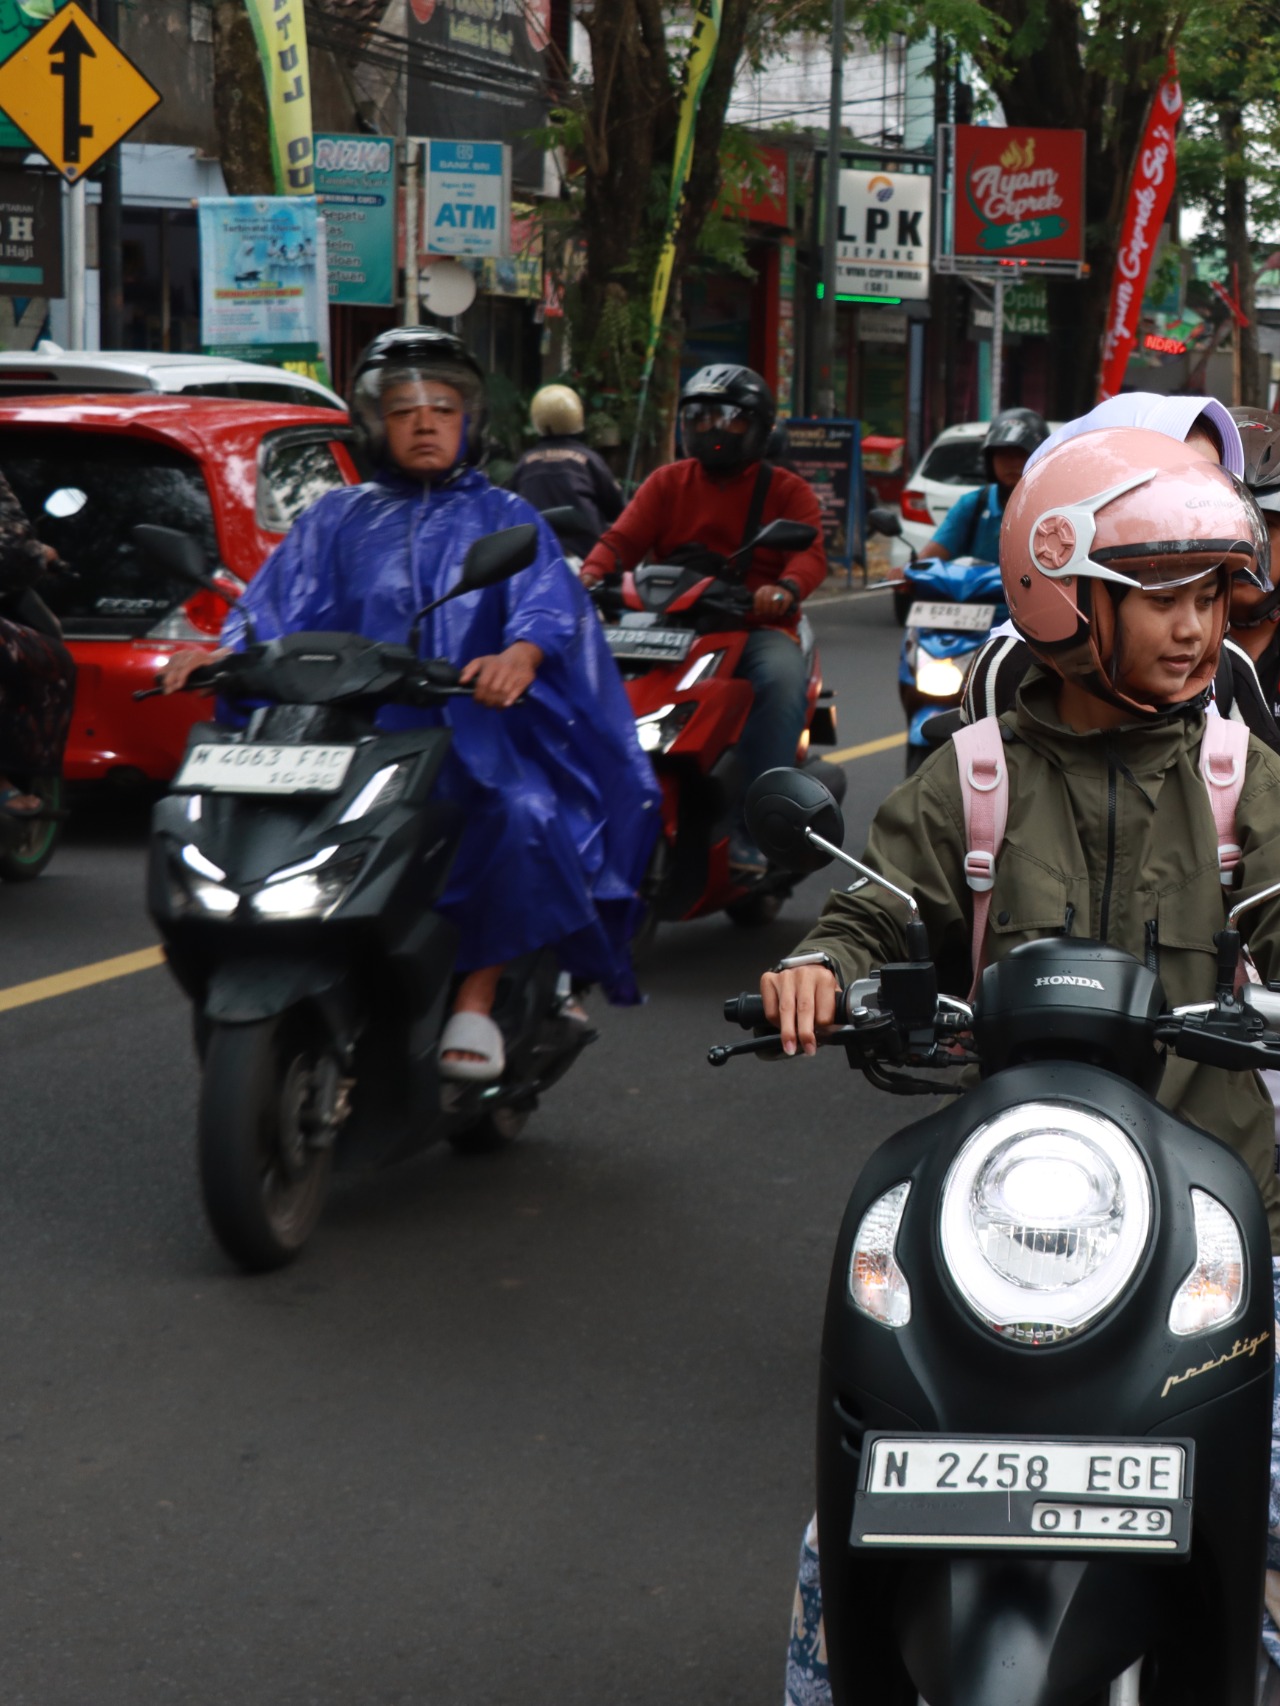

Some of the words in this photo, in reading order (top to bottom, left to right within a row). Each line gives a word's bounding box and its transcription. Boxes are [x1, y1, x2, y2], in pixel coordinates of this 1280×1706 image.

[316, 140, 391, 173] RIZKA
[972, 164, 1059, 201] Ayam
[435, 203, 496, 230] ATM
[983, 187, 1063, 221] Geprek
[838, 206, 923, 247] LPK
[1006, 220, 1041, 245] Sa'i
[1118, 185, 1156, 280] Geprek
[842, 247, 914, 260] JEPANG
[1034, 975, 1105, 990] HONDA
[1160, 1331, 1270, 1398] prestige
[884, 1451, 909, 1488] N
[936, 1452, 1049, 1492] 2458
[1086, 1456, 1171, 1492] EGE
